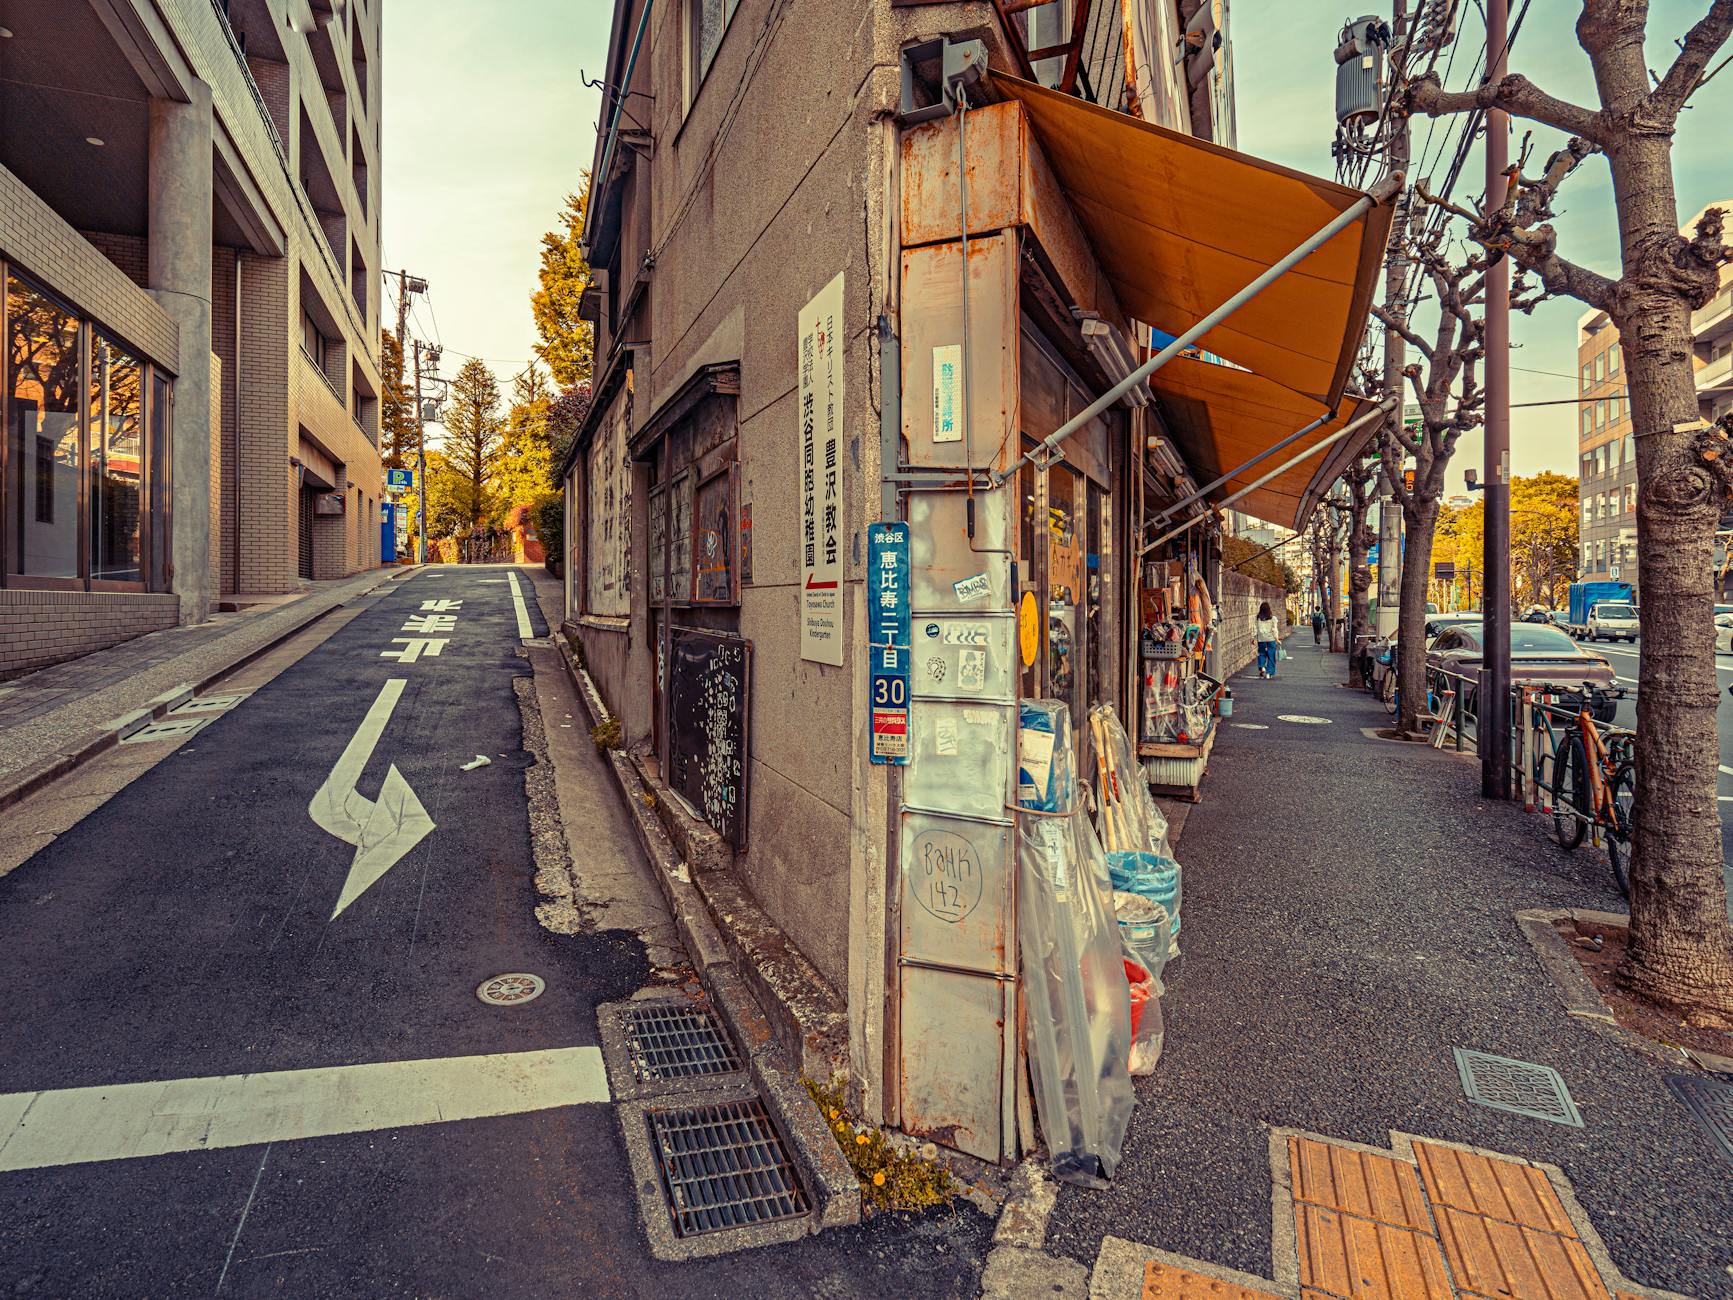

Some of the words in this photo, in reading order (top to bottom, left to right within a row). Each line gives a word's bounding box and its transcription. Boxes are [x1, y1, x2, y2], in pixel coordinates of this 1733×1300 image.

[393, 471, 404, 484] P
[804, 393, 815, 567] 渋谷同胞幼稚園
[825, 438, 836, 565] 豊沢教会
[874, 532, 904, 544] 渋谷区
[822, 600, 835, 609] Church
[880, 551, 899, 669] 恵比寿二丁目
[806, 617, 820, 628] Shibuya
[380, 599, 464, 663] 止まれ
[809, 630, 831, 641] Kindergarten
[875, 678, 905, 705] 30
[878, 734, 903, 742] 恵比寿店
